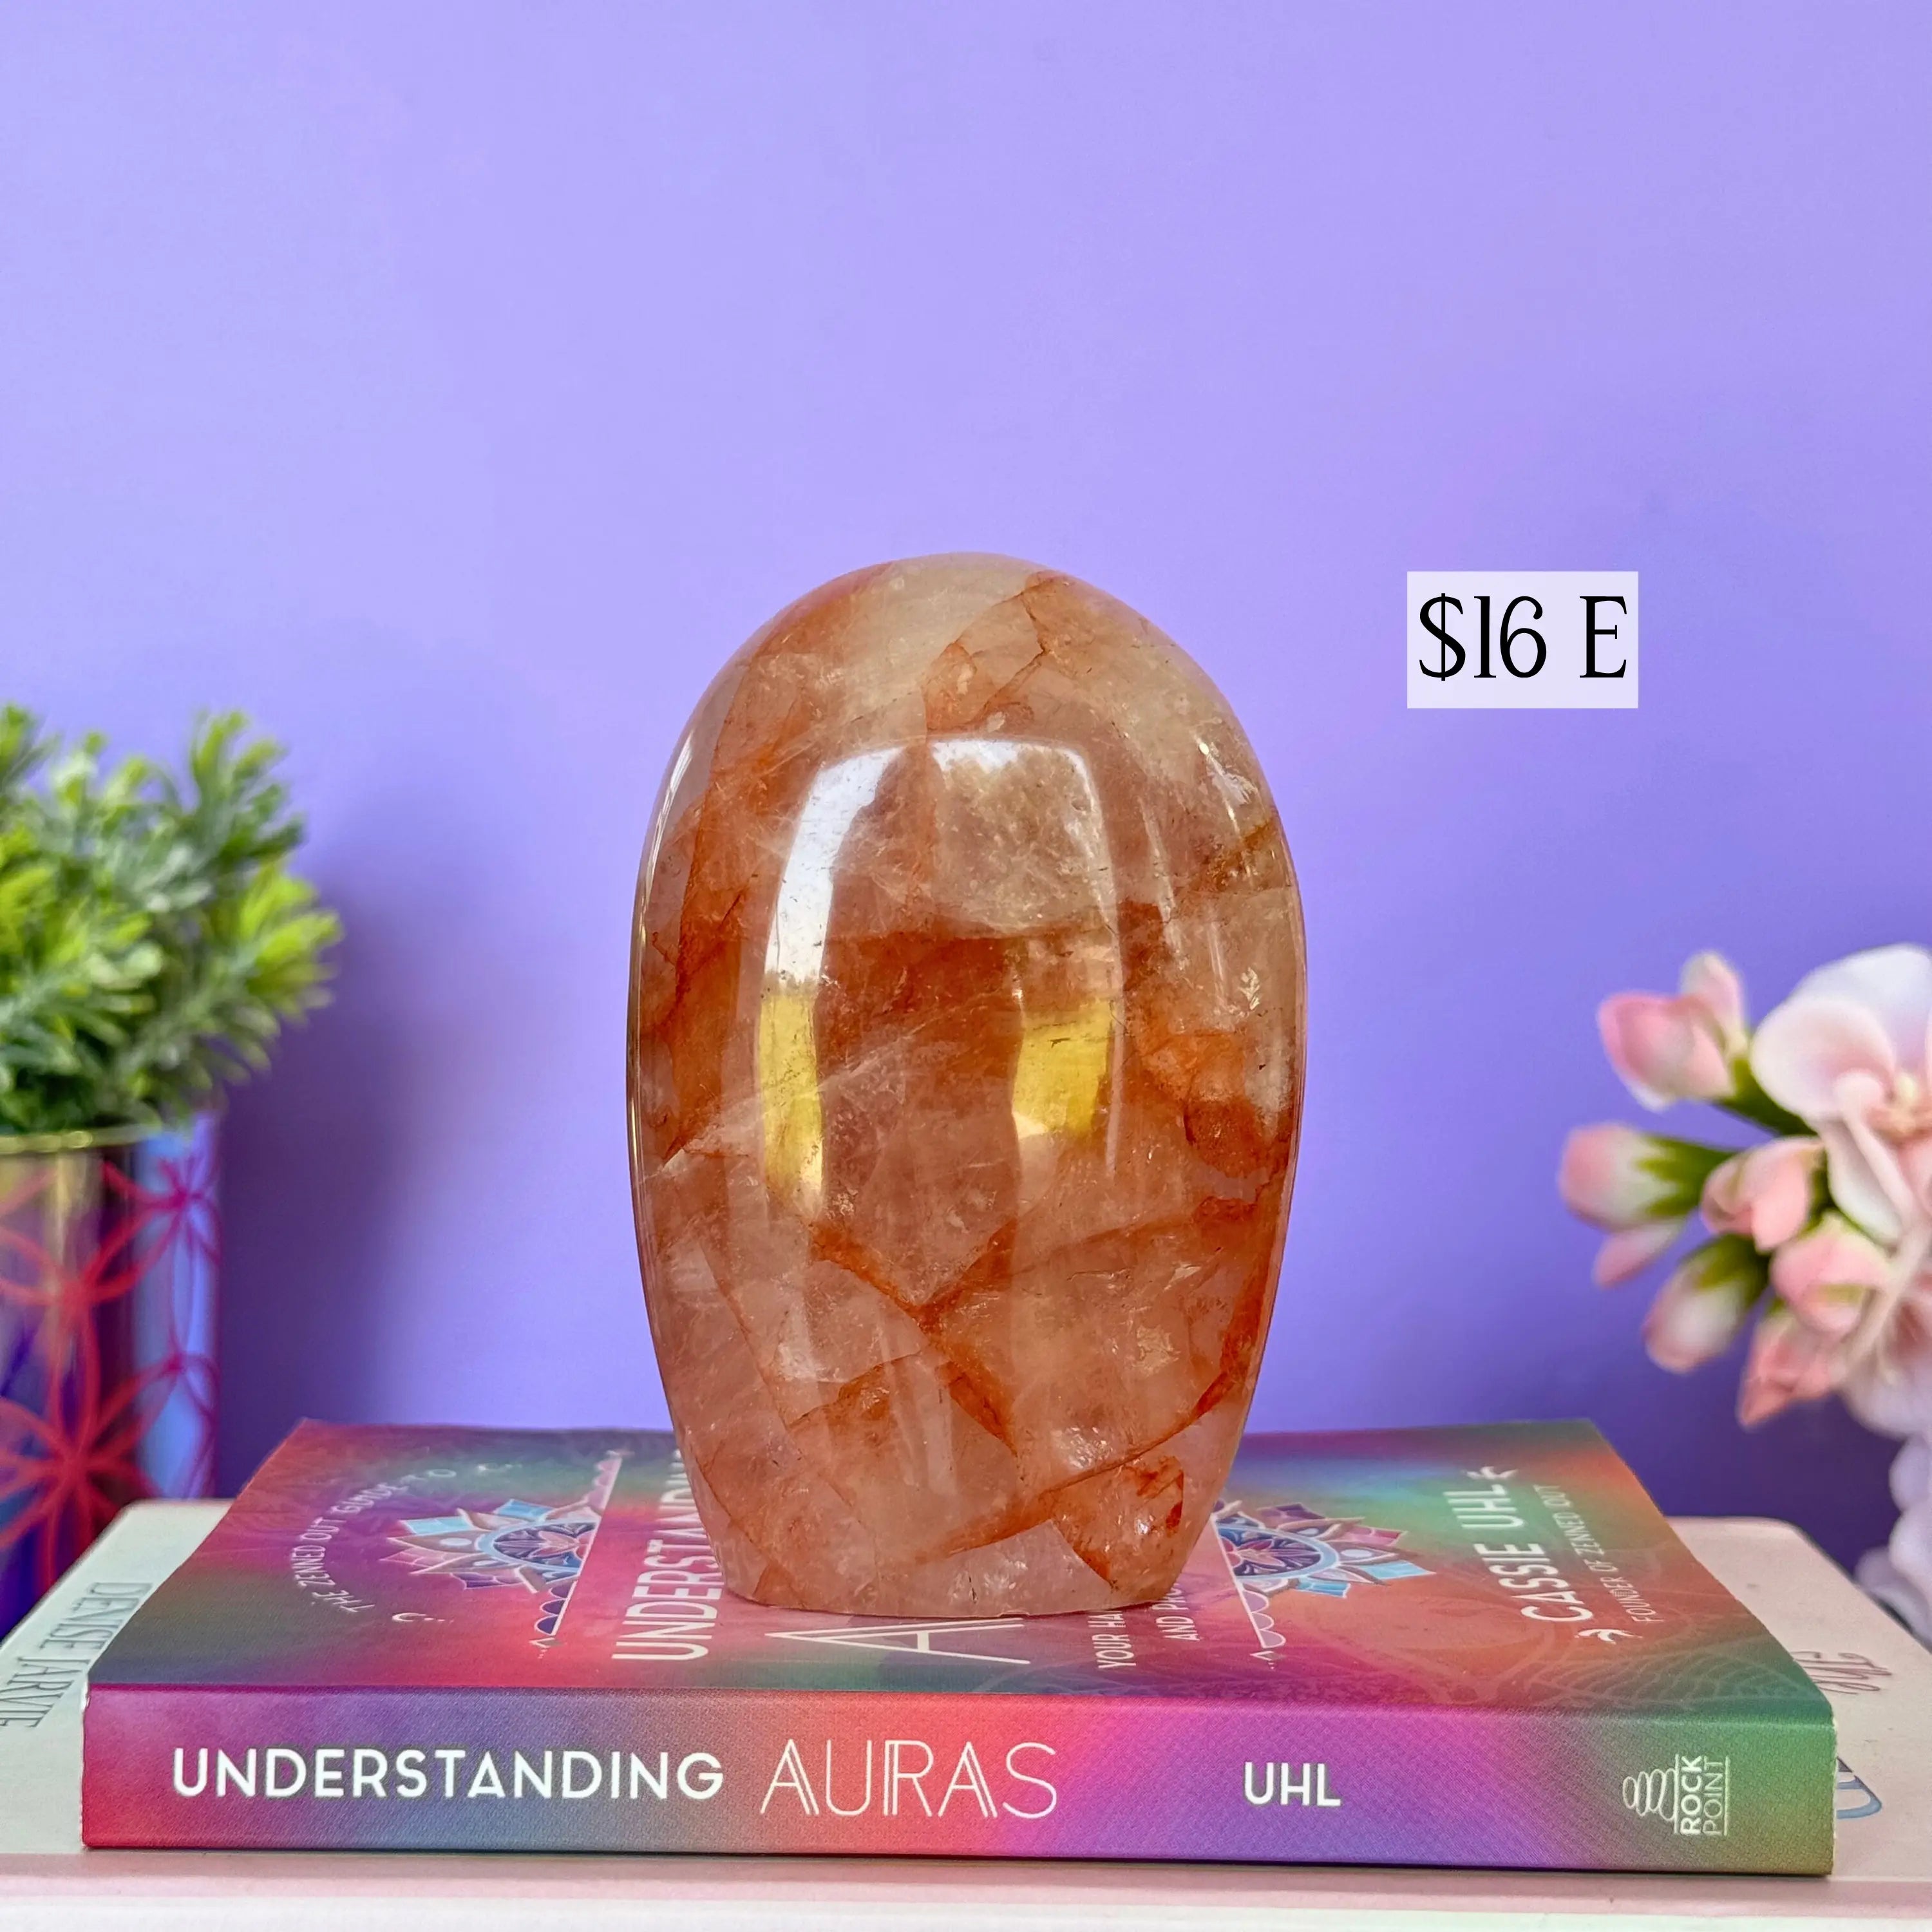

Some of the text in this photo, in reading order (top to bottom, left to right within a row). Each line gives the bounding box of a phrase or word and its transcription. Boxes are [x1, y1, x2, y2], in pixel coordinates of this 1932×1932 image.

[299, 1517, 346, 1541] OUT
[1552, 1512, 1604, 1555] ZENNED
[291, 1545, 336, 1587] ZENNED
[1442, 1484, 1594, 1622] CASSIE UHL
[1584, 1559, 1618, 1572] OF
[40, 1582, 153, 1649] DENISE
[312, 1589, 375, 1613] THE
[1600, 1577, 1664, 1622] FOUNDER
[1156, 1616, 1200, 1640] AND
[1092, 1634, 1137, 1668] YOUR
[173, 1739, 1057, 1819] UNDERSTANDING AURAS
[1245, 1761, 1341, 1806] UHL
[1680, 1756, 1702, 1835] ROCK
[1702, 1756, 1723, 1835] POINT
